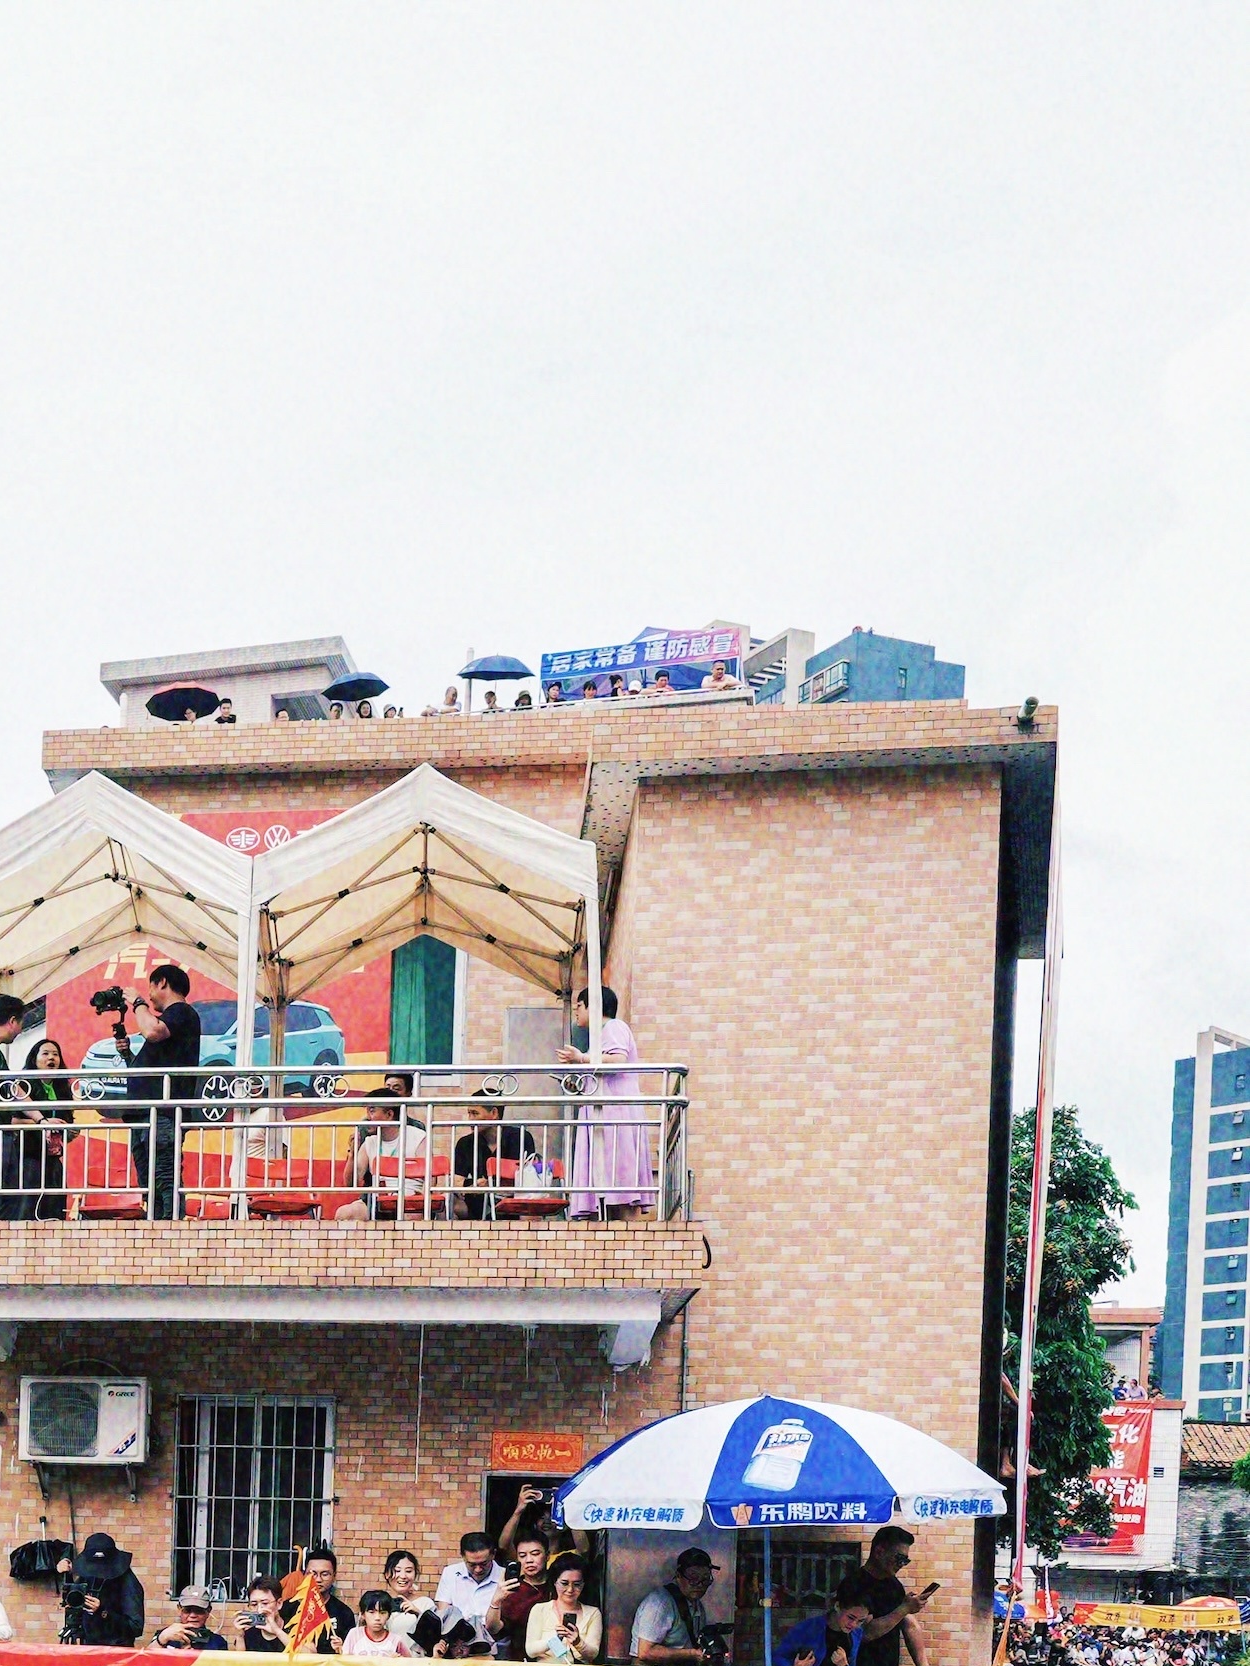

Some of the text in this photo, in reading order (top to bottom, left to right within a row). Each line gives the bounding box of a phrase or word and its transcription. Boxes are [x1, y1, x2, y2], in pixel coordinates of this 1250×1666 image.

[550, 633, 734, 674] 居家常备 谨防感冒
[590, 1504, 685, 1525] 快速补充电解质
[758, 1502, 868, 1523] 东鹏饮料
[919, 1496, 994, 1516] 快速补充电解质
